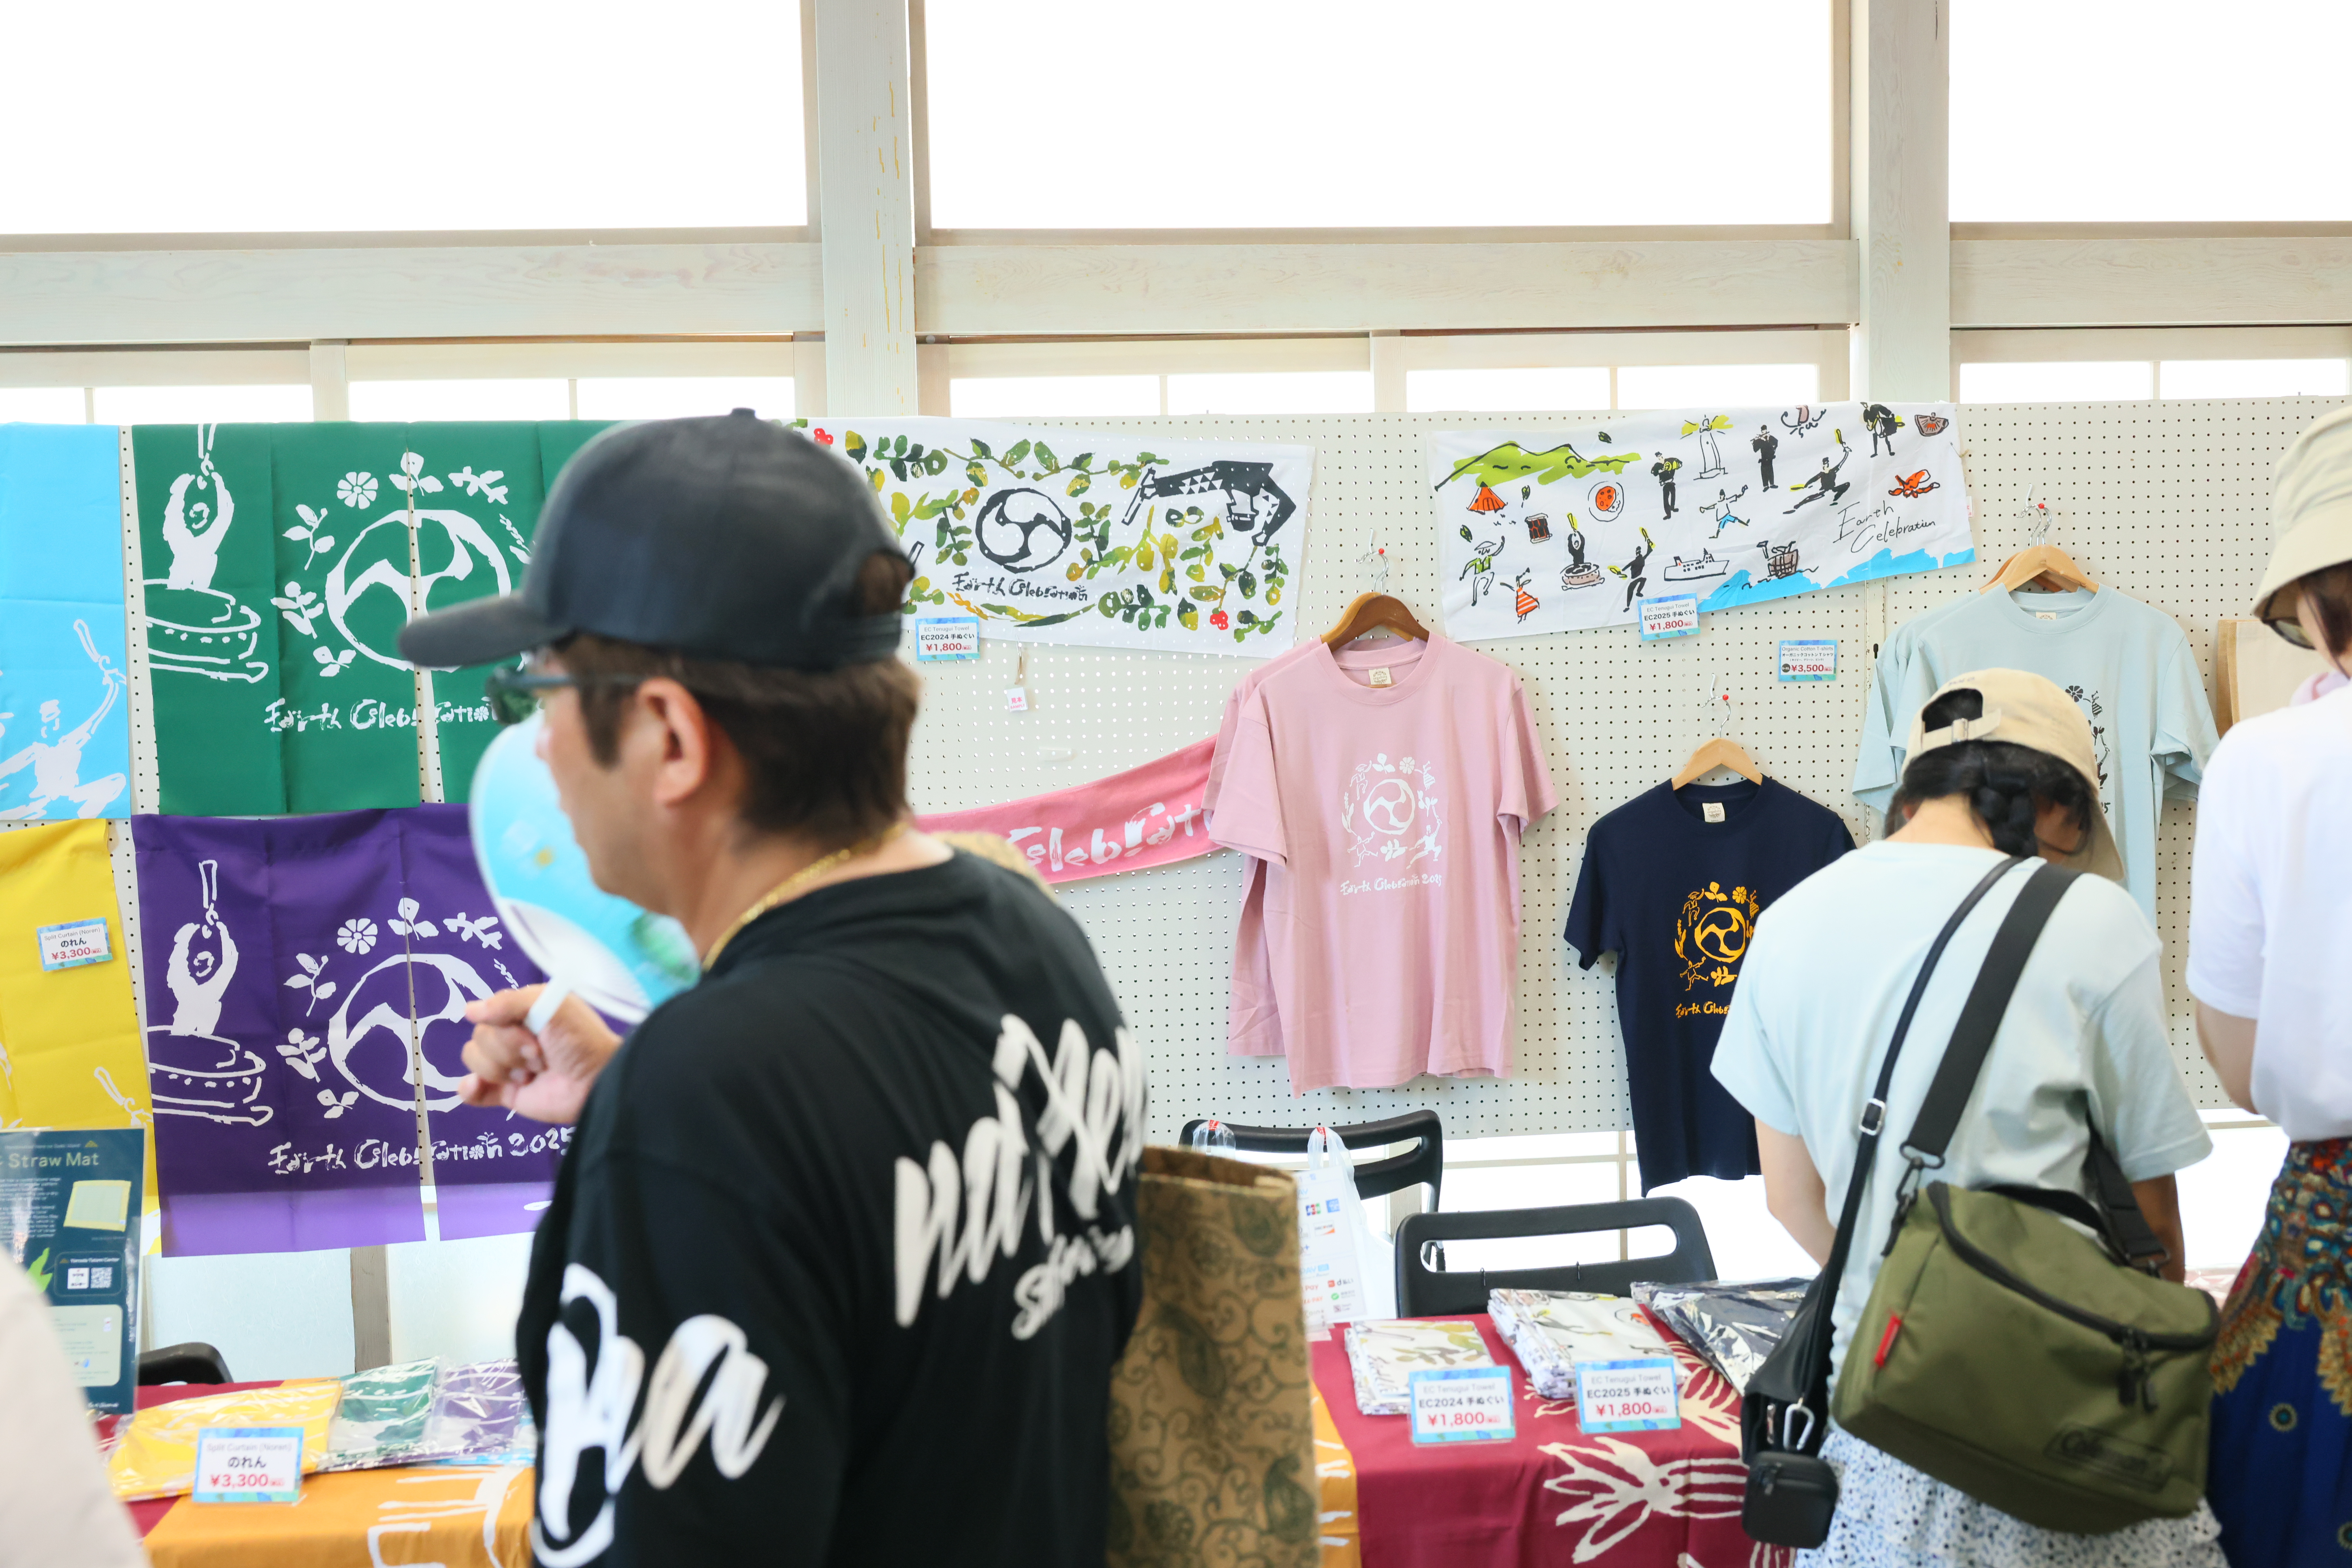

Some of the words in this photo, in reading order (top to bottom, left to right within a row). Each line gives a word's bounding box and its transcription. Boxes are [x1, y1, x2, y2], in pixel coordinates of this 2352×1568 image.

[1832, 500, 1894, 543] Earth
[1850, 516, 1936, 553] Celebration
[952, 571, 1006, 596] Earth
[1009, 579, 1088, 601] Celebration
[1644, 613, 1670, 621] EC2025
[264, 698, 342, 732] Earth
[1340, 880, 1371, 895] Earth
[79, 927, 100, 936] (Noren)
[61, 938, 87, 947] のれん
[1676, 1003, 1701, 1018] Earth
[9, 1153, 62, 1168] Straw
[66, 1152, 99, 1166] Mat
[268, 1142, 346, 1175] Earth
[1587, 1388, 1630, 1398] EC2025
[1419, 1398, 1463, 1408] EC2024
[228, 1457, 266, 1468] のれん
